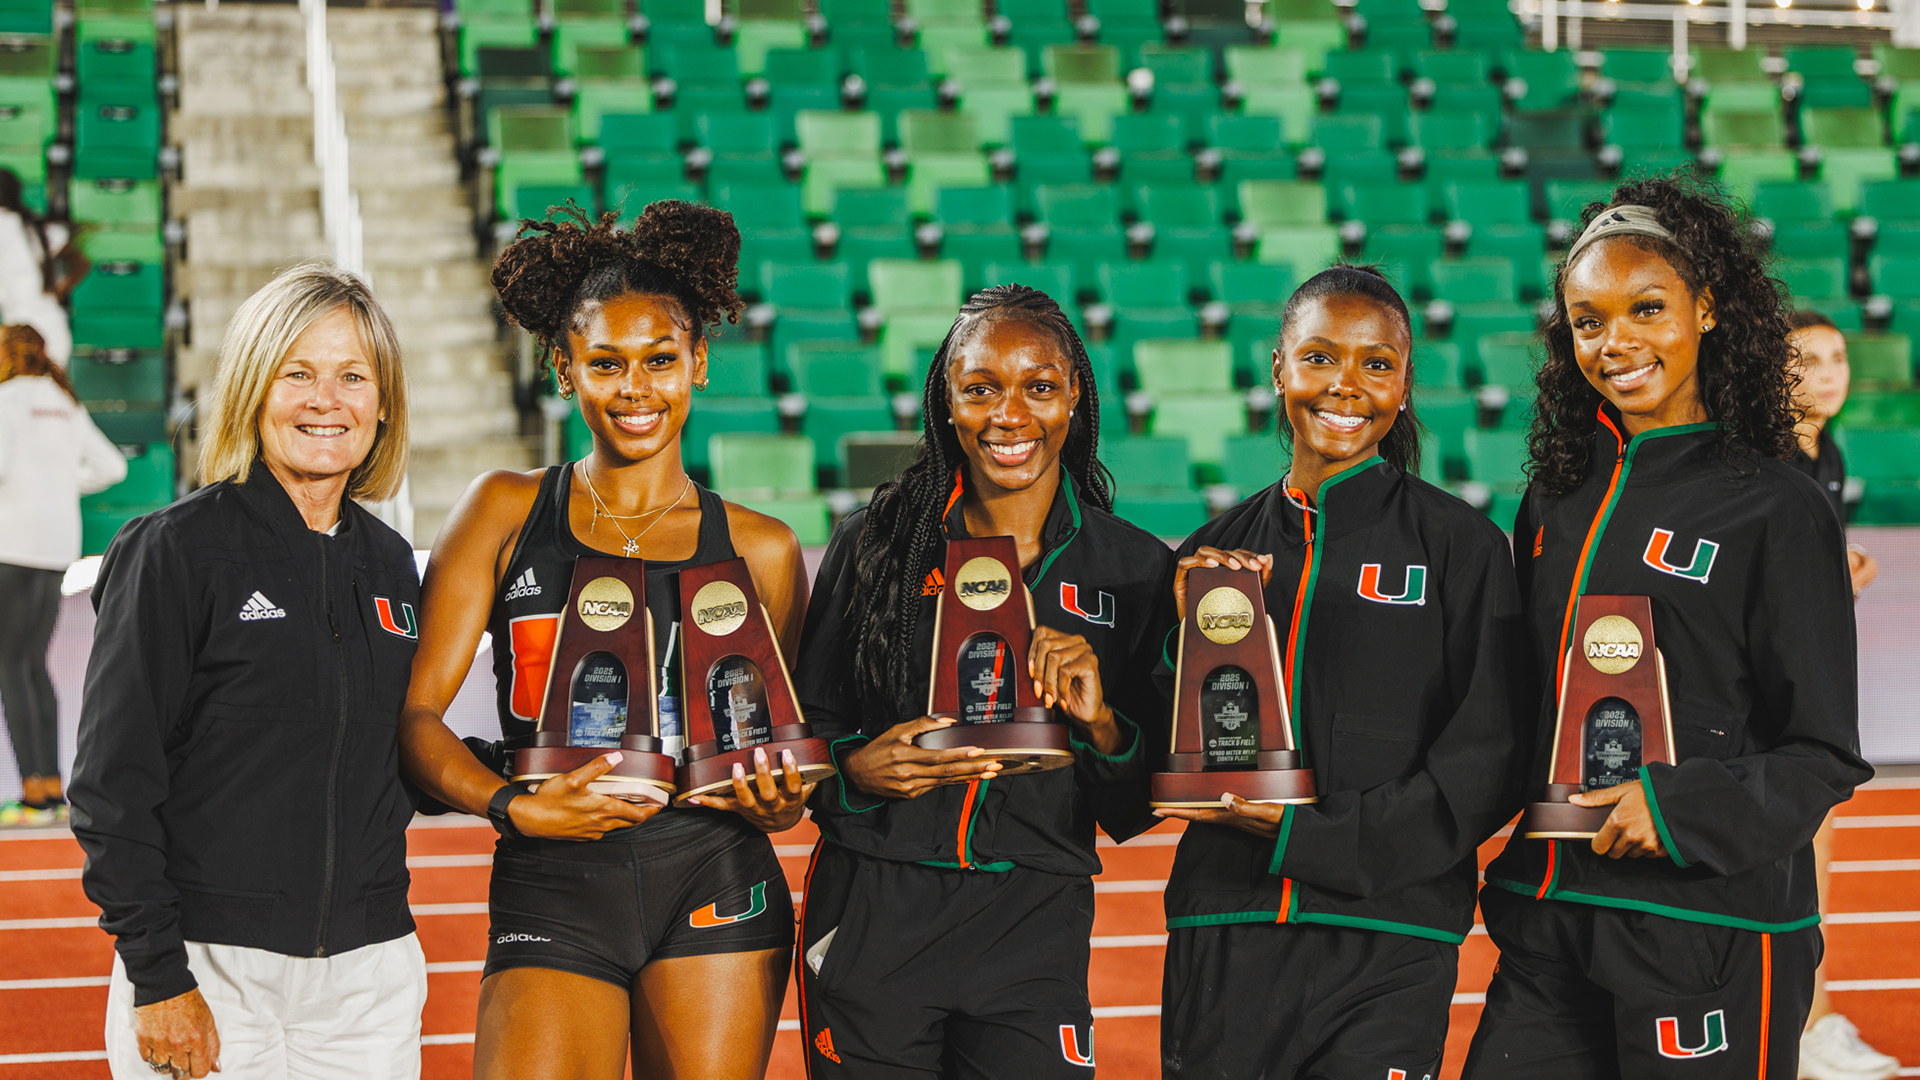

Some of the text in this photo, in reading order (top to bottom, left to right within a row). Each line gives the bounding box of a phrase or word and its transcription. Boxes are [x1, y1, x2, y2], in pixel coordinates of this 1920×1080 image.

[1643, 527, 1719, 583] U
[920, 584, 944, 596] dida
[961, 580, 1008, 597] NCAA
[1357, 564, 1426, 605] U
[505, 586, 542, 602] adidas
[581, 600, 630, 617] NCAA
[1060, 581, 1115, 627] U
[239, 608, 286, 621] adidas
[373, 596, 418, 639] U
[698, 601, 745, 625] NCAA
[1202, 612, 1250, 629] NCAA
[976, 642, 996, 650] 2025
[1588, 642, 1639, 658] NCAA
[968, 648, 1001, 659] DIVISION
[593, 666, 614, 675] 2025
[724, 668, 744, 678] 2025
[584, 674, 616, 683] DIVISION
[718, 674, 749, 688] DIVISION
[1220, 674, 1240, 682] 2025
[1211, 682, 1245, 691] DIVISION
[1604, 710, 1625, 719] 2025
[1595, 719, 1630, 728] DIVISION
[753, 727, 767, 735] FIELD
[690, 880, 767, 928] U
[1656, 1009, 1727, 1058] U
